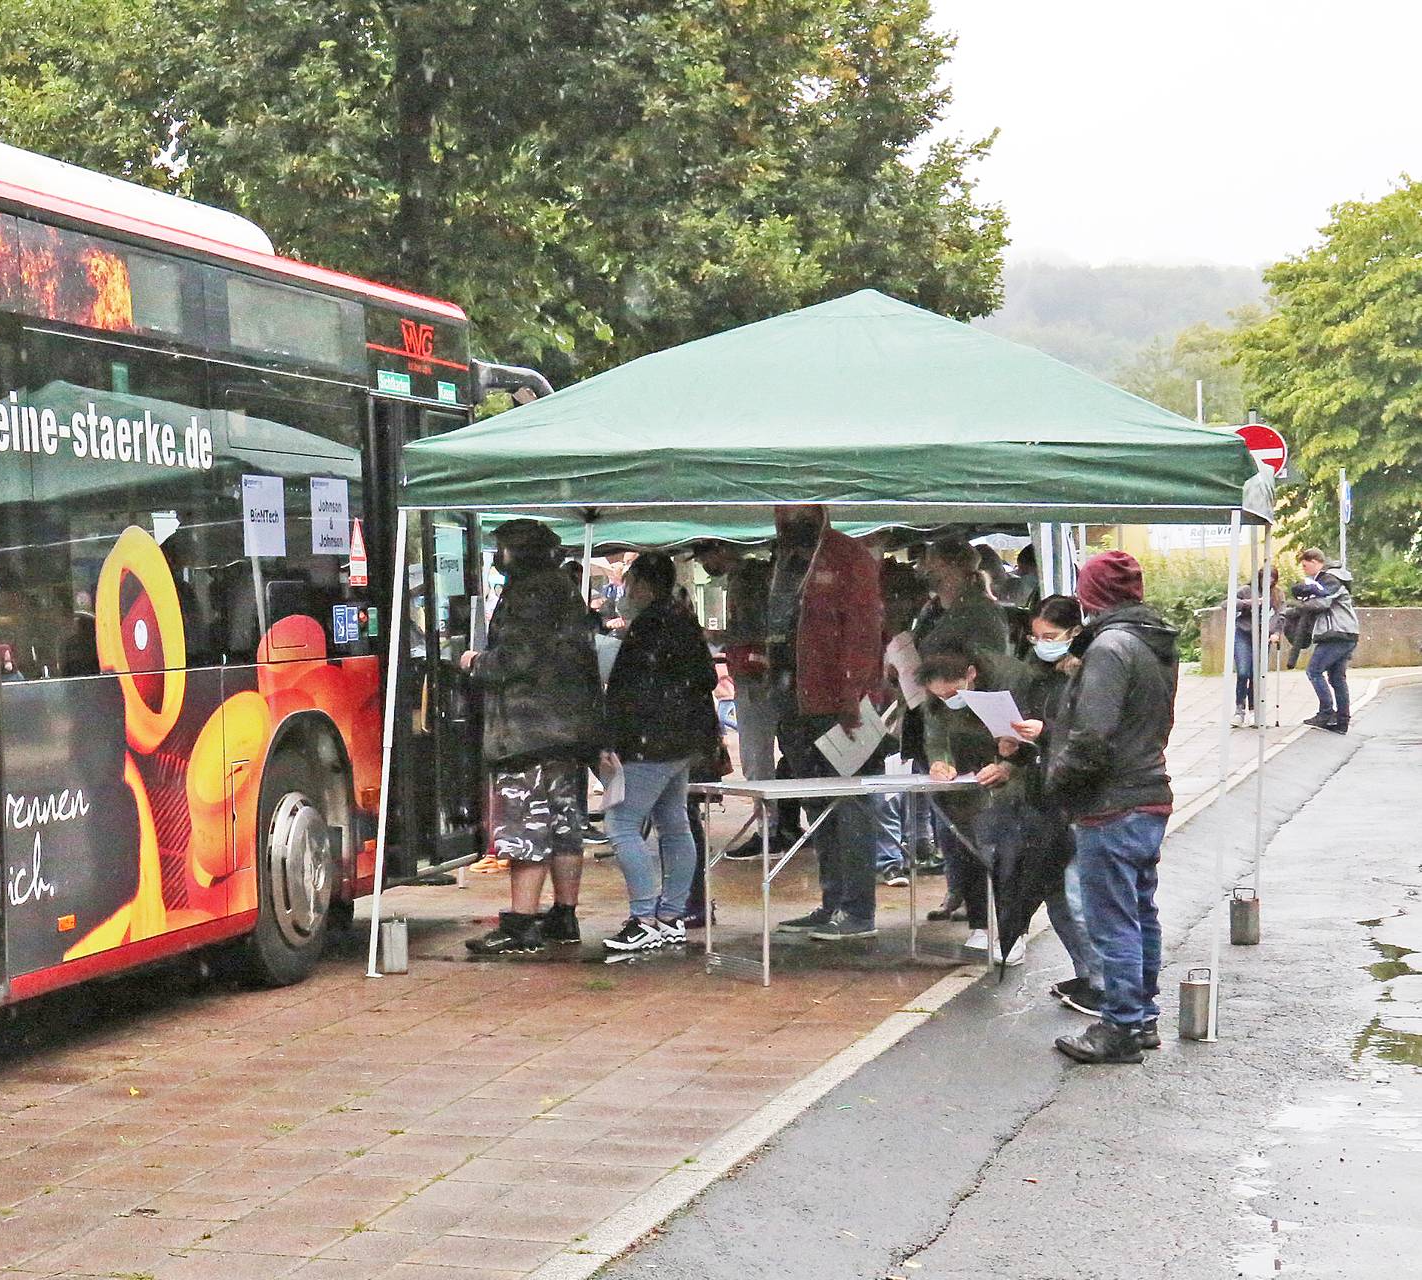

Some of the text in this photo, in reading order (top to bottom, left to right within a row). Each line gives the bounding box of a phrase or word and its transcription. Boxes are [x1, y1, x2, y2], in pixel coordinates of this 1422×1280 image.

[318, 500, 343, 513] Johnson
[250, 508, 280, 524] BioNTech
[319, 534, 344, 548] Johnson
